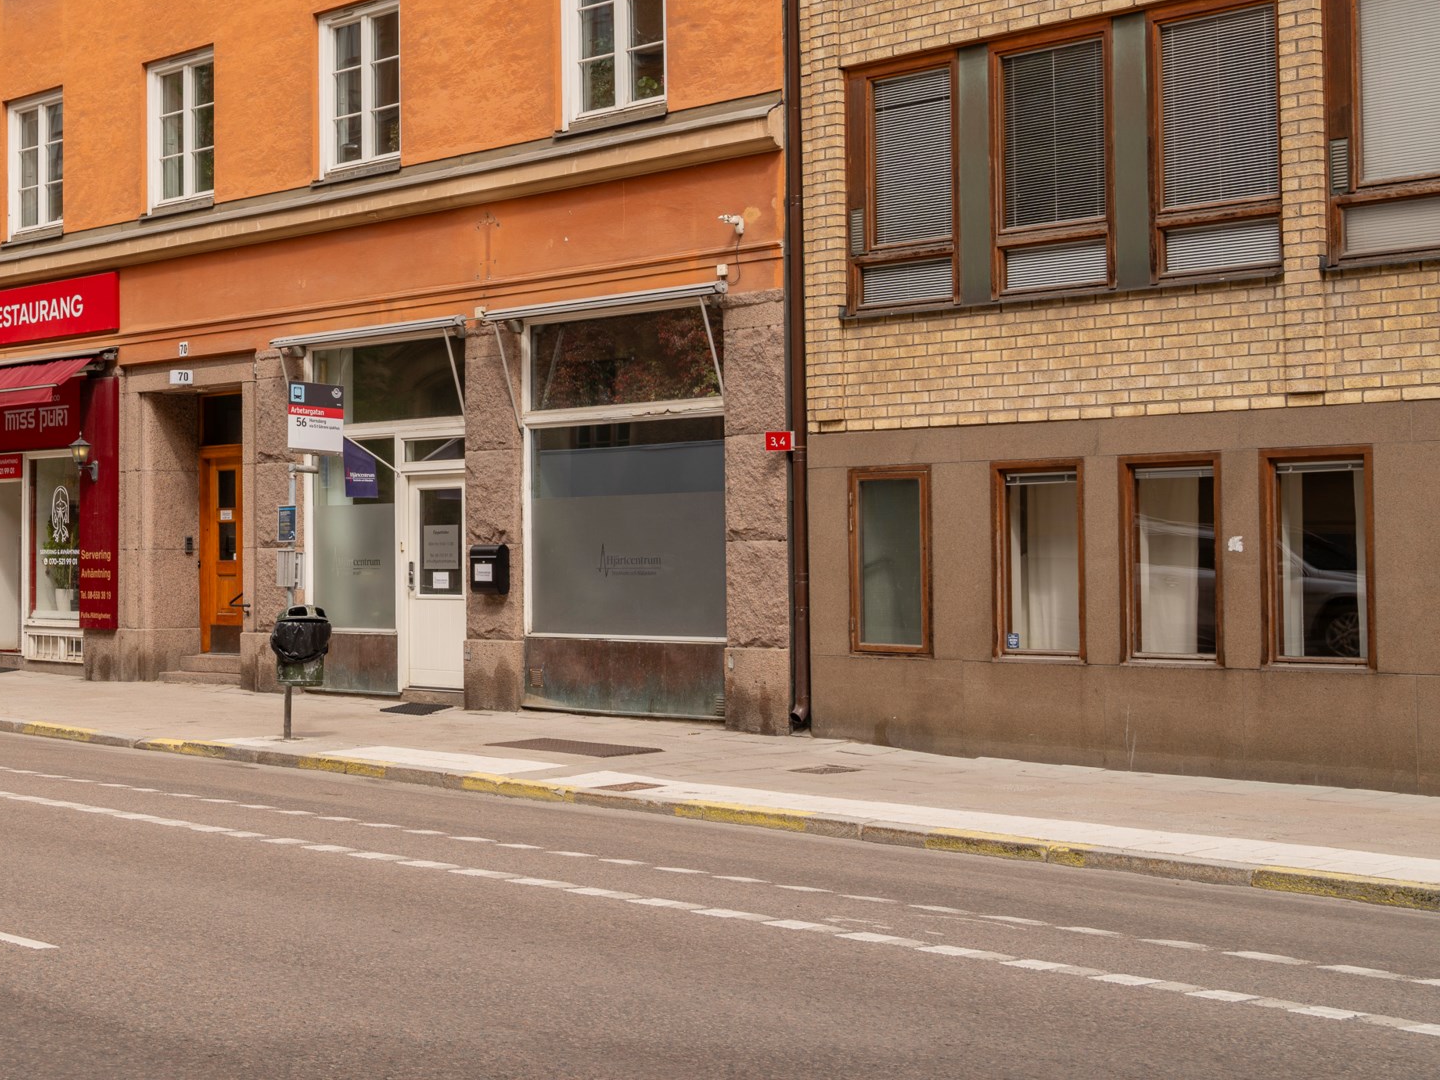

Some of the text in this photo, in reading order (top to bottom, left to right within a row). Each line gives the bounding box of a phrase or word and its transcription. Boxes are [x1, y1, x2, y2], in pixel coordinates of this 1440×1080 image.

[180, 344, 188, 355] 70
[178, 372, 188, 381] 70
[291, 406, 324, 416] Arbetargatan
[296, 417, 307, 427] 56
[81, 550, 111, 562] Servering
[81, 568, 111, 580] Avhämtning
